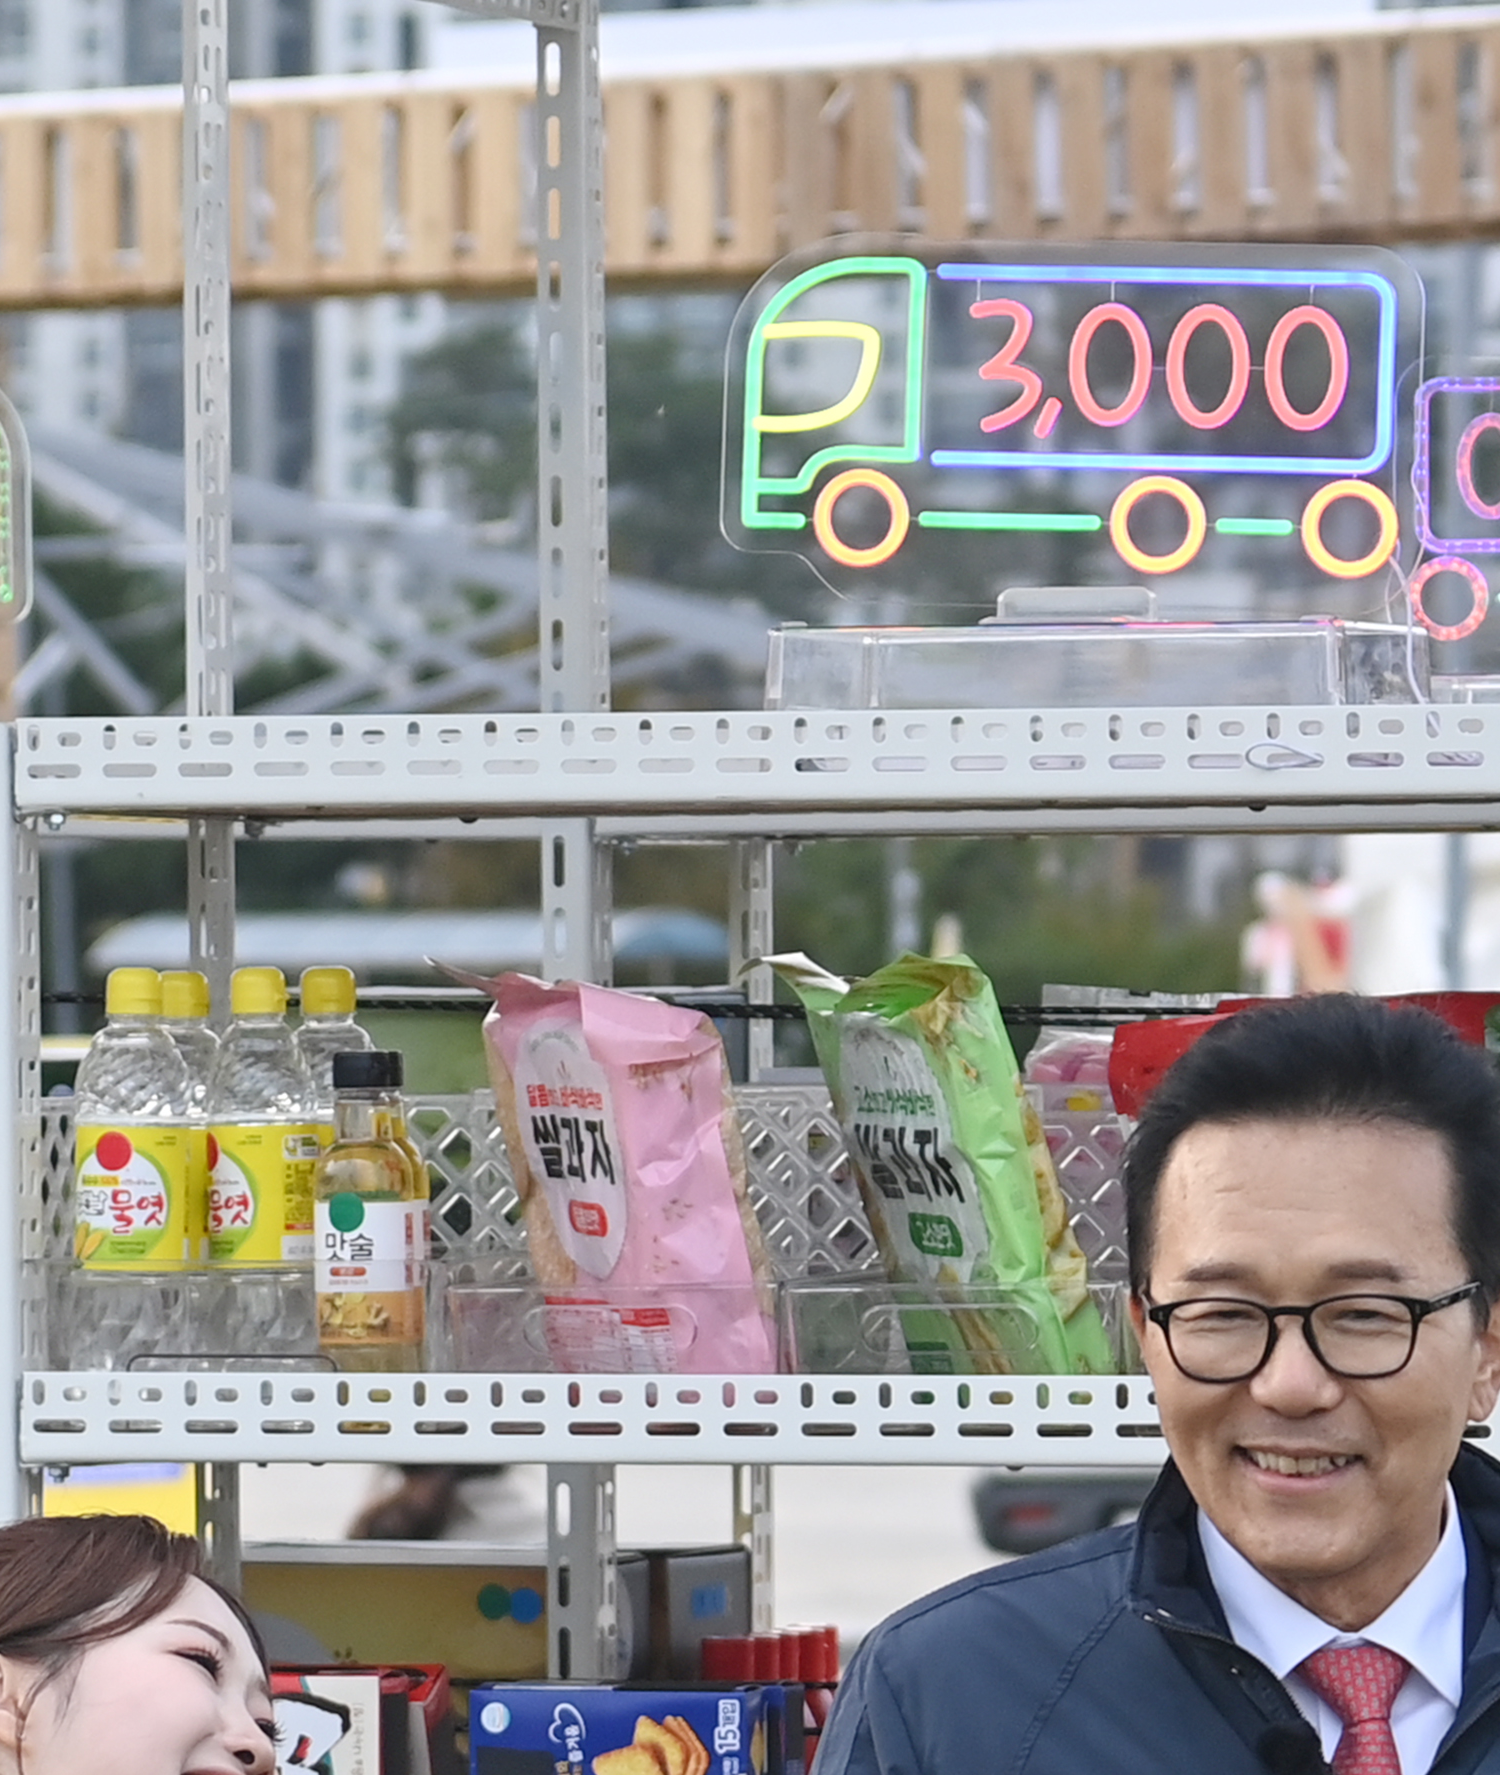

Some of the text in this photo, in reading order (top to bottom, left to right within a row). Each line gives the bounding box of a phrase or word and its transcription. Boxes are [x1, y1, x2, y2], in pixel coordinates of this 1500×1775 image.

[969, 297, 1349, 439] 3,000
[531, 1113, 616, 1186] 쌀과자
[854, 1122, 966, 1204] 쌀과자
[108, 1187, 165, 1235] 물엿
[325, 1232, 375, 1262] 맛술
